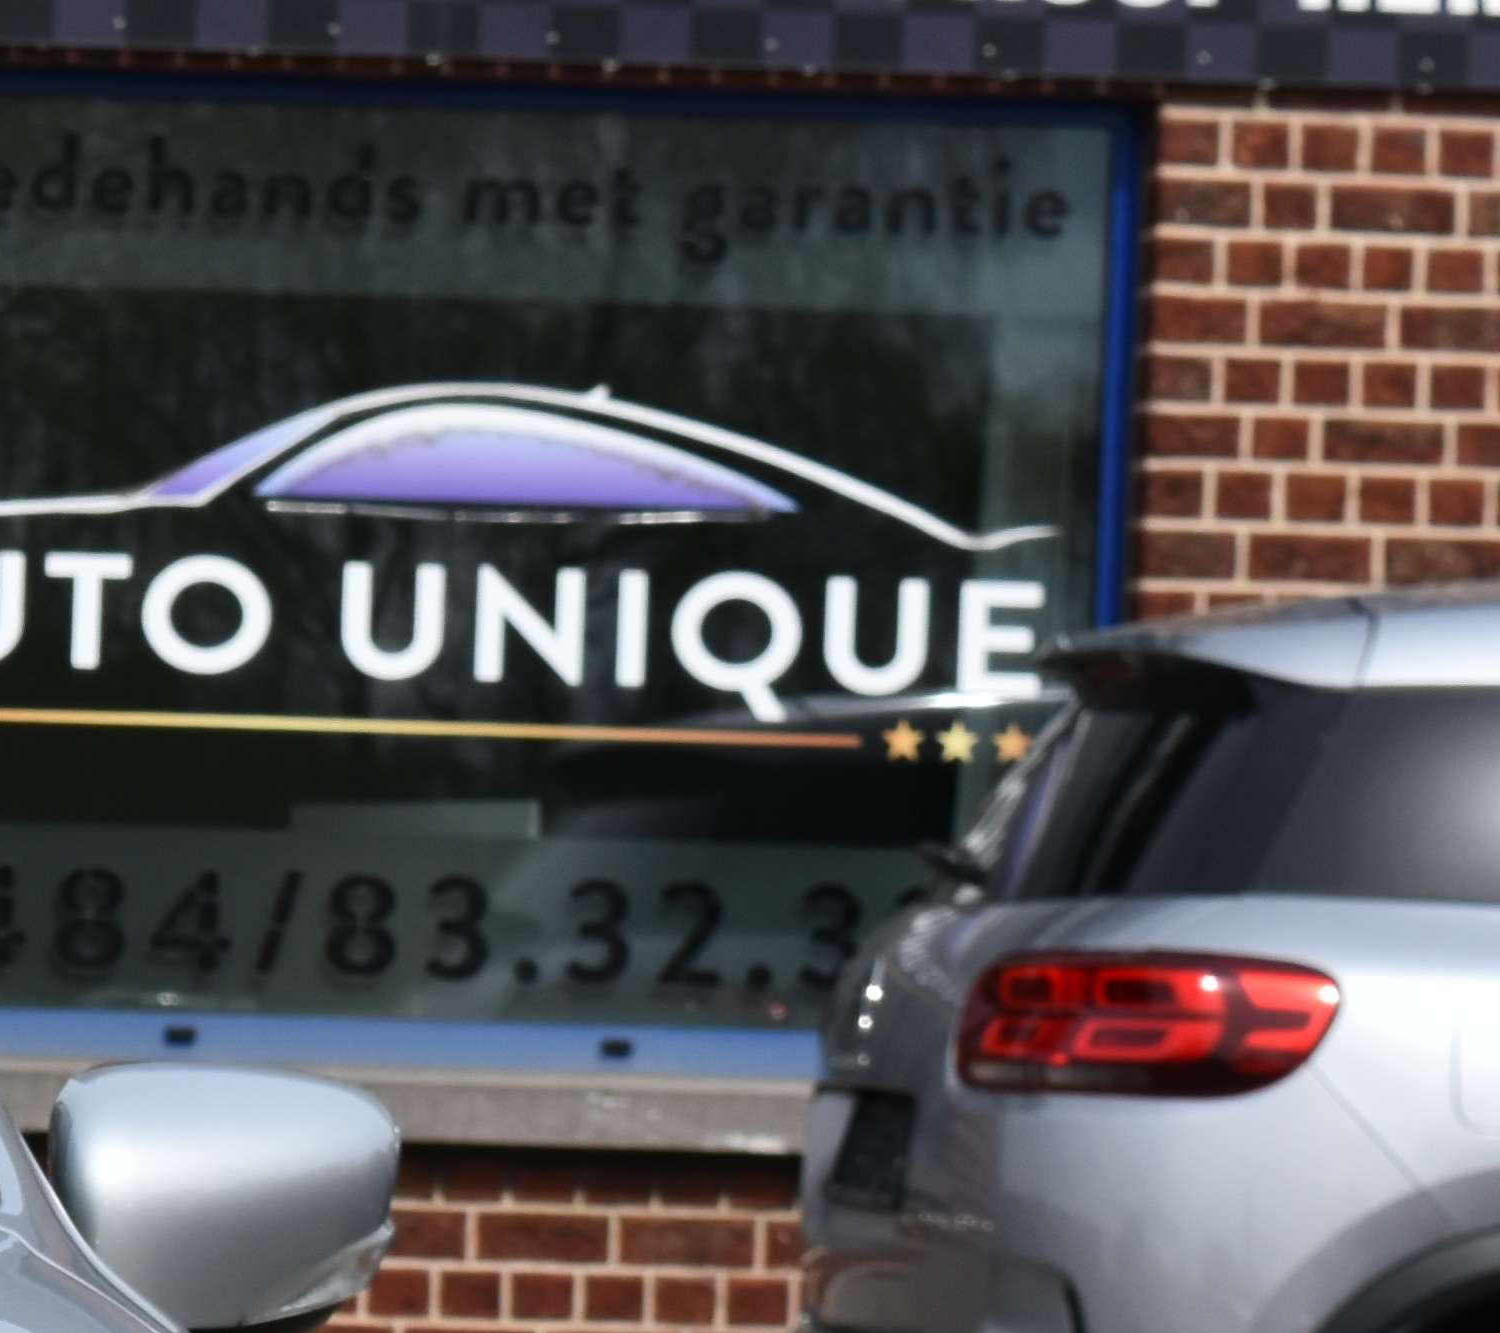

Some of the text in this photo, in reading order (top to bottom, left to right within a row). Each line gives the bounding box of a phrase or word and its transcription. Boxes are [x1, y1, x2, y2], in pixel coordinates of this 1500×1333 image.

[463, 165, 642, 226] met
[680, 156, 1071, 265] garantie
[340, 560, 1046, 723] UNIQUE
